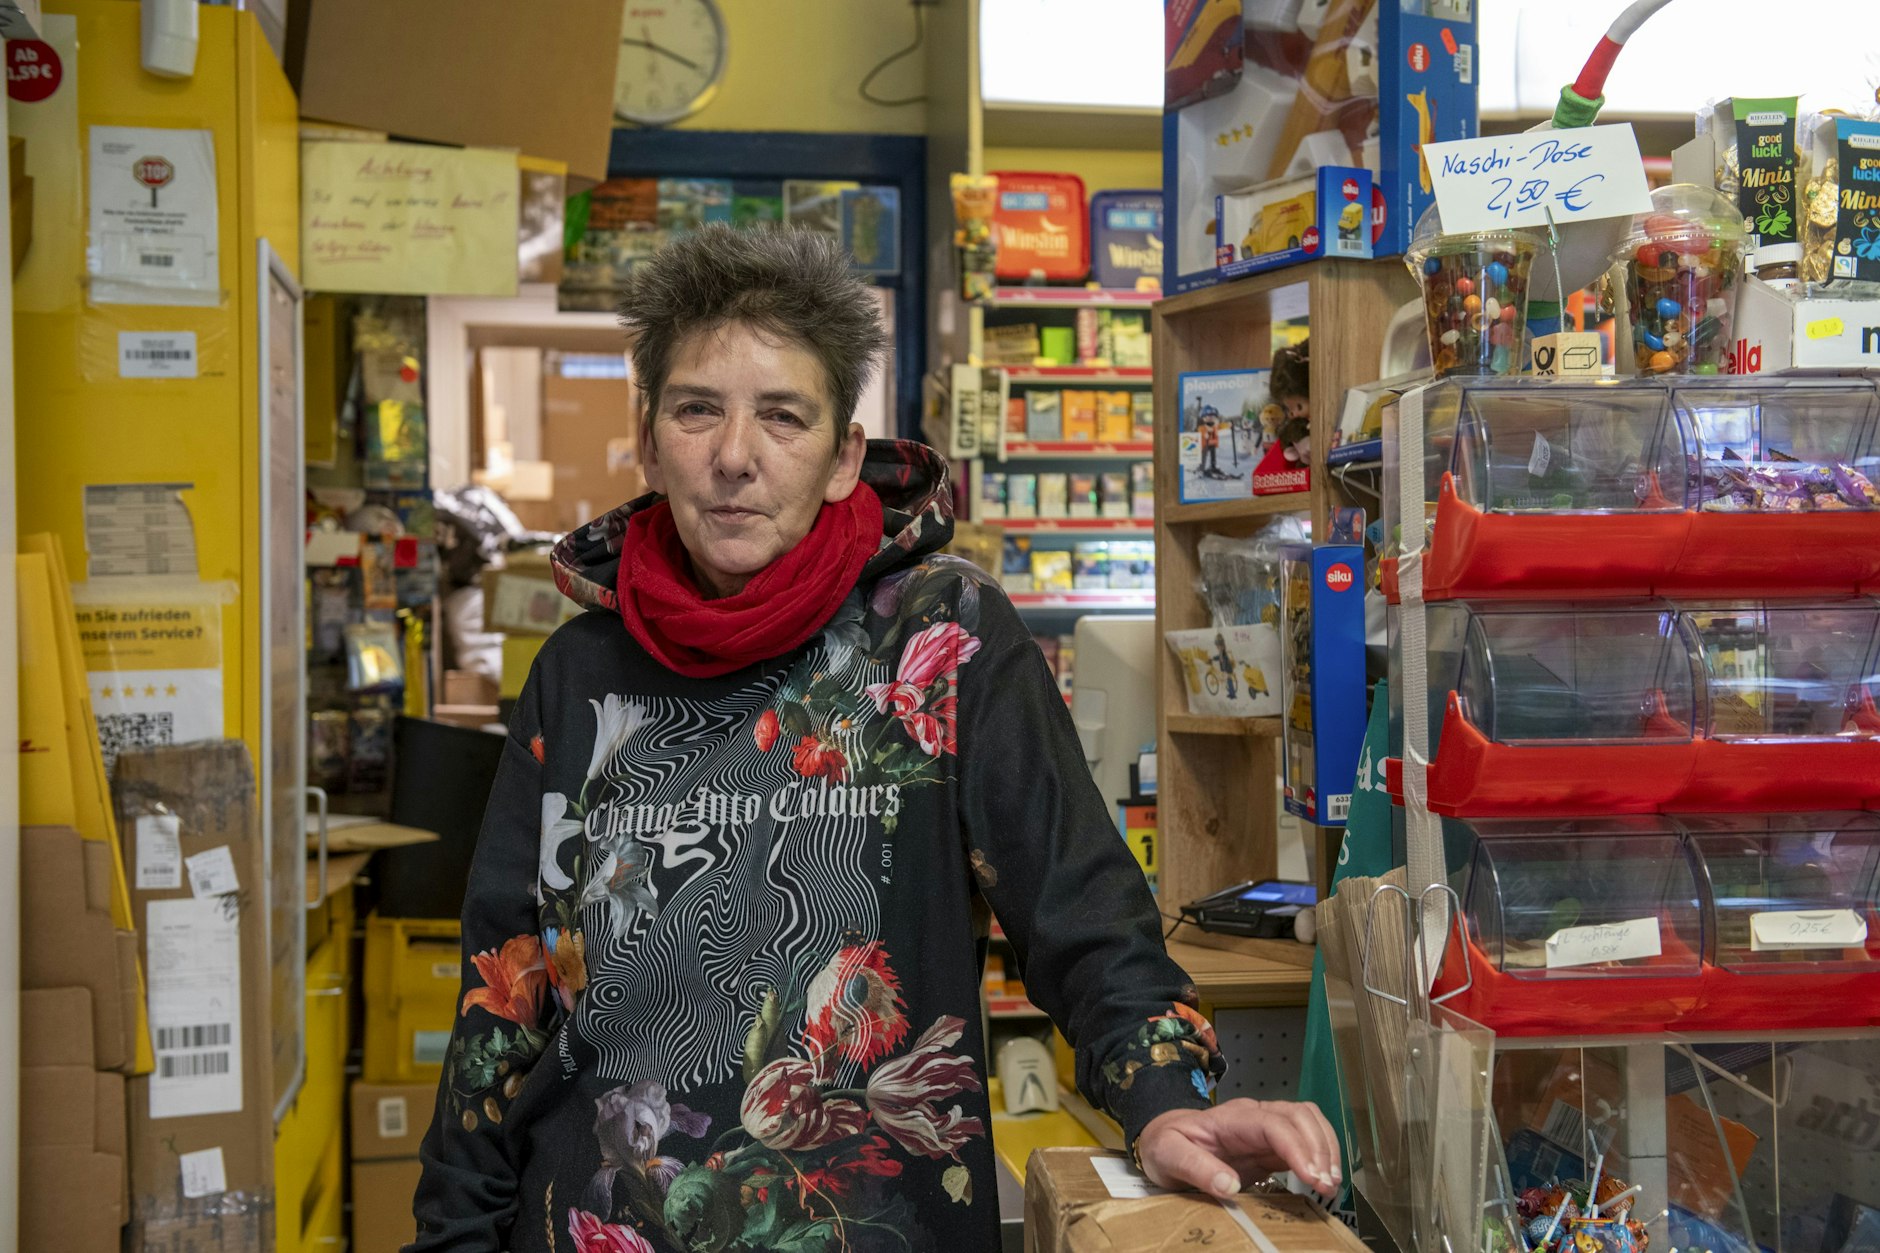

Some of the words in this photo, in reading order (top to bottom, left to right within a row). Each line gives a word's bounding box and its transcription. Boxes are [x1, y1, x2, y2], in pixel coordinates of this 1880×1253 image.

[15, 47, 39, 63] Ab
[1413, 44, 1424, 71] siku
[1749, 114, 1784, 122] RIEGELEIN
[1758, 133, 1782, 146] good
[1752, 145, 1782, 158] luck!
[1742, 166, 1793, 188] Minis
[1487, 177, 1549, 218] 2,50
[1555, 174, 1605, 211] €
[1302, 234, 1319, 247] siku
[1727, 338, 1761, 375] ella
[1327, 571, 1352, 582] siku
[95, 610, 117, 622] Sie
[121, 609, 191, 622] zufrieden
[80, 628, 137, 641] nserem
[141, 626, 203, 640] Service?
[585, 797, 688, 842] Change
[687, 786, 760, 828] Into
[768, 775, 901, 822] Colours
